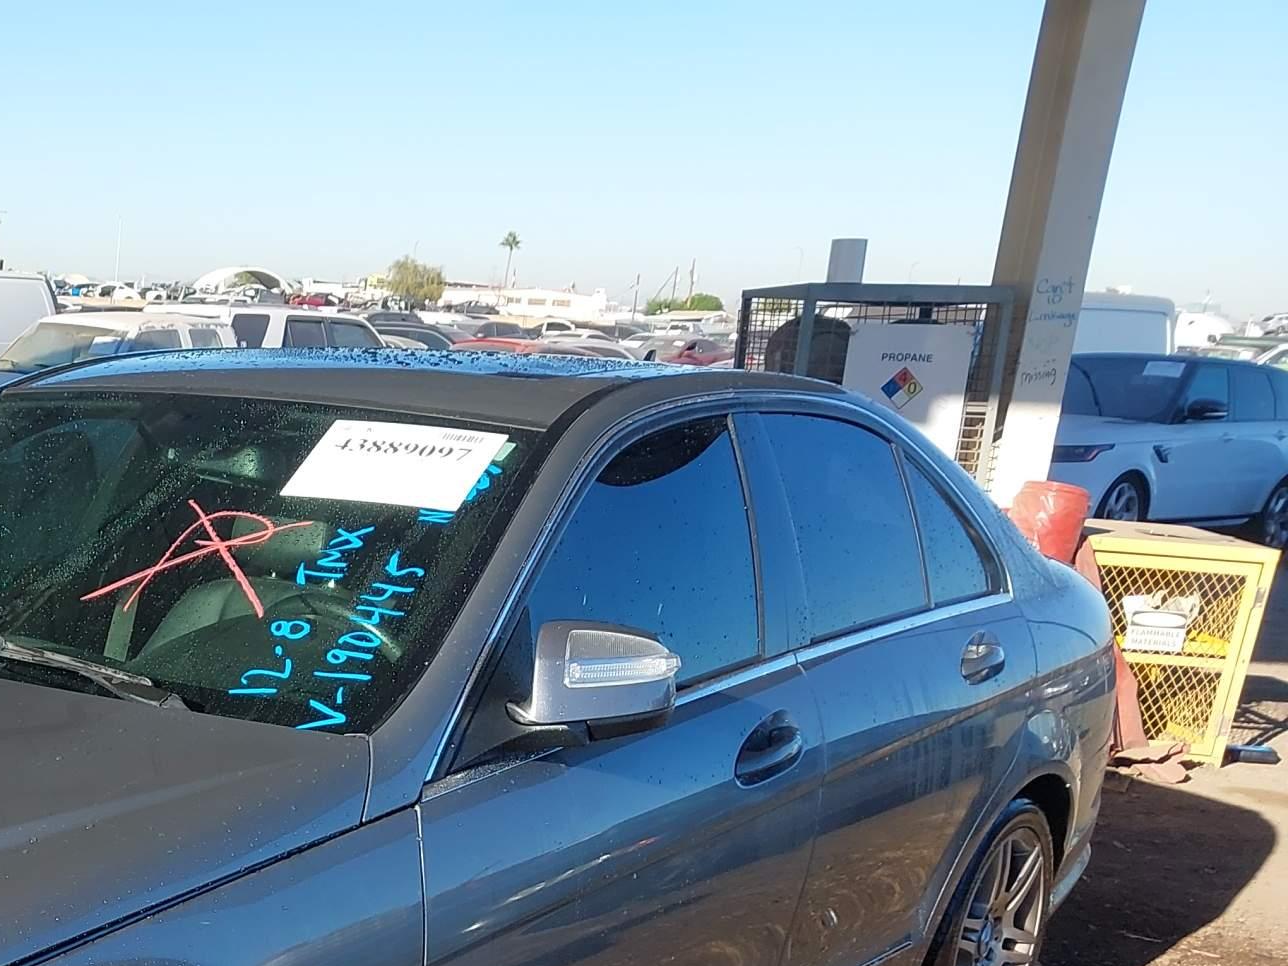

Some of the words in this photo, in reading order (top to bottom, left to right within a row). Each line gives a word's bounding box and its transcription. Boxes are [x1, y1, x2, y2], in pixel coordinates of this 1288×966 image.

[881, 352, 934, 363] PROPANE
[907, 381, 917, 395] 0
[334, 437, 474, 463] 43889097
